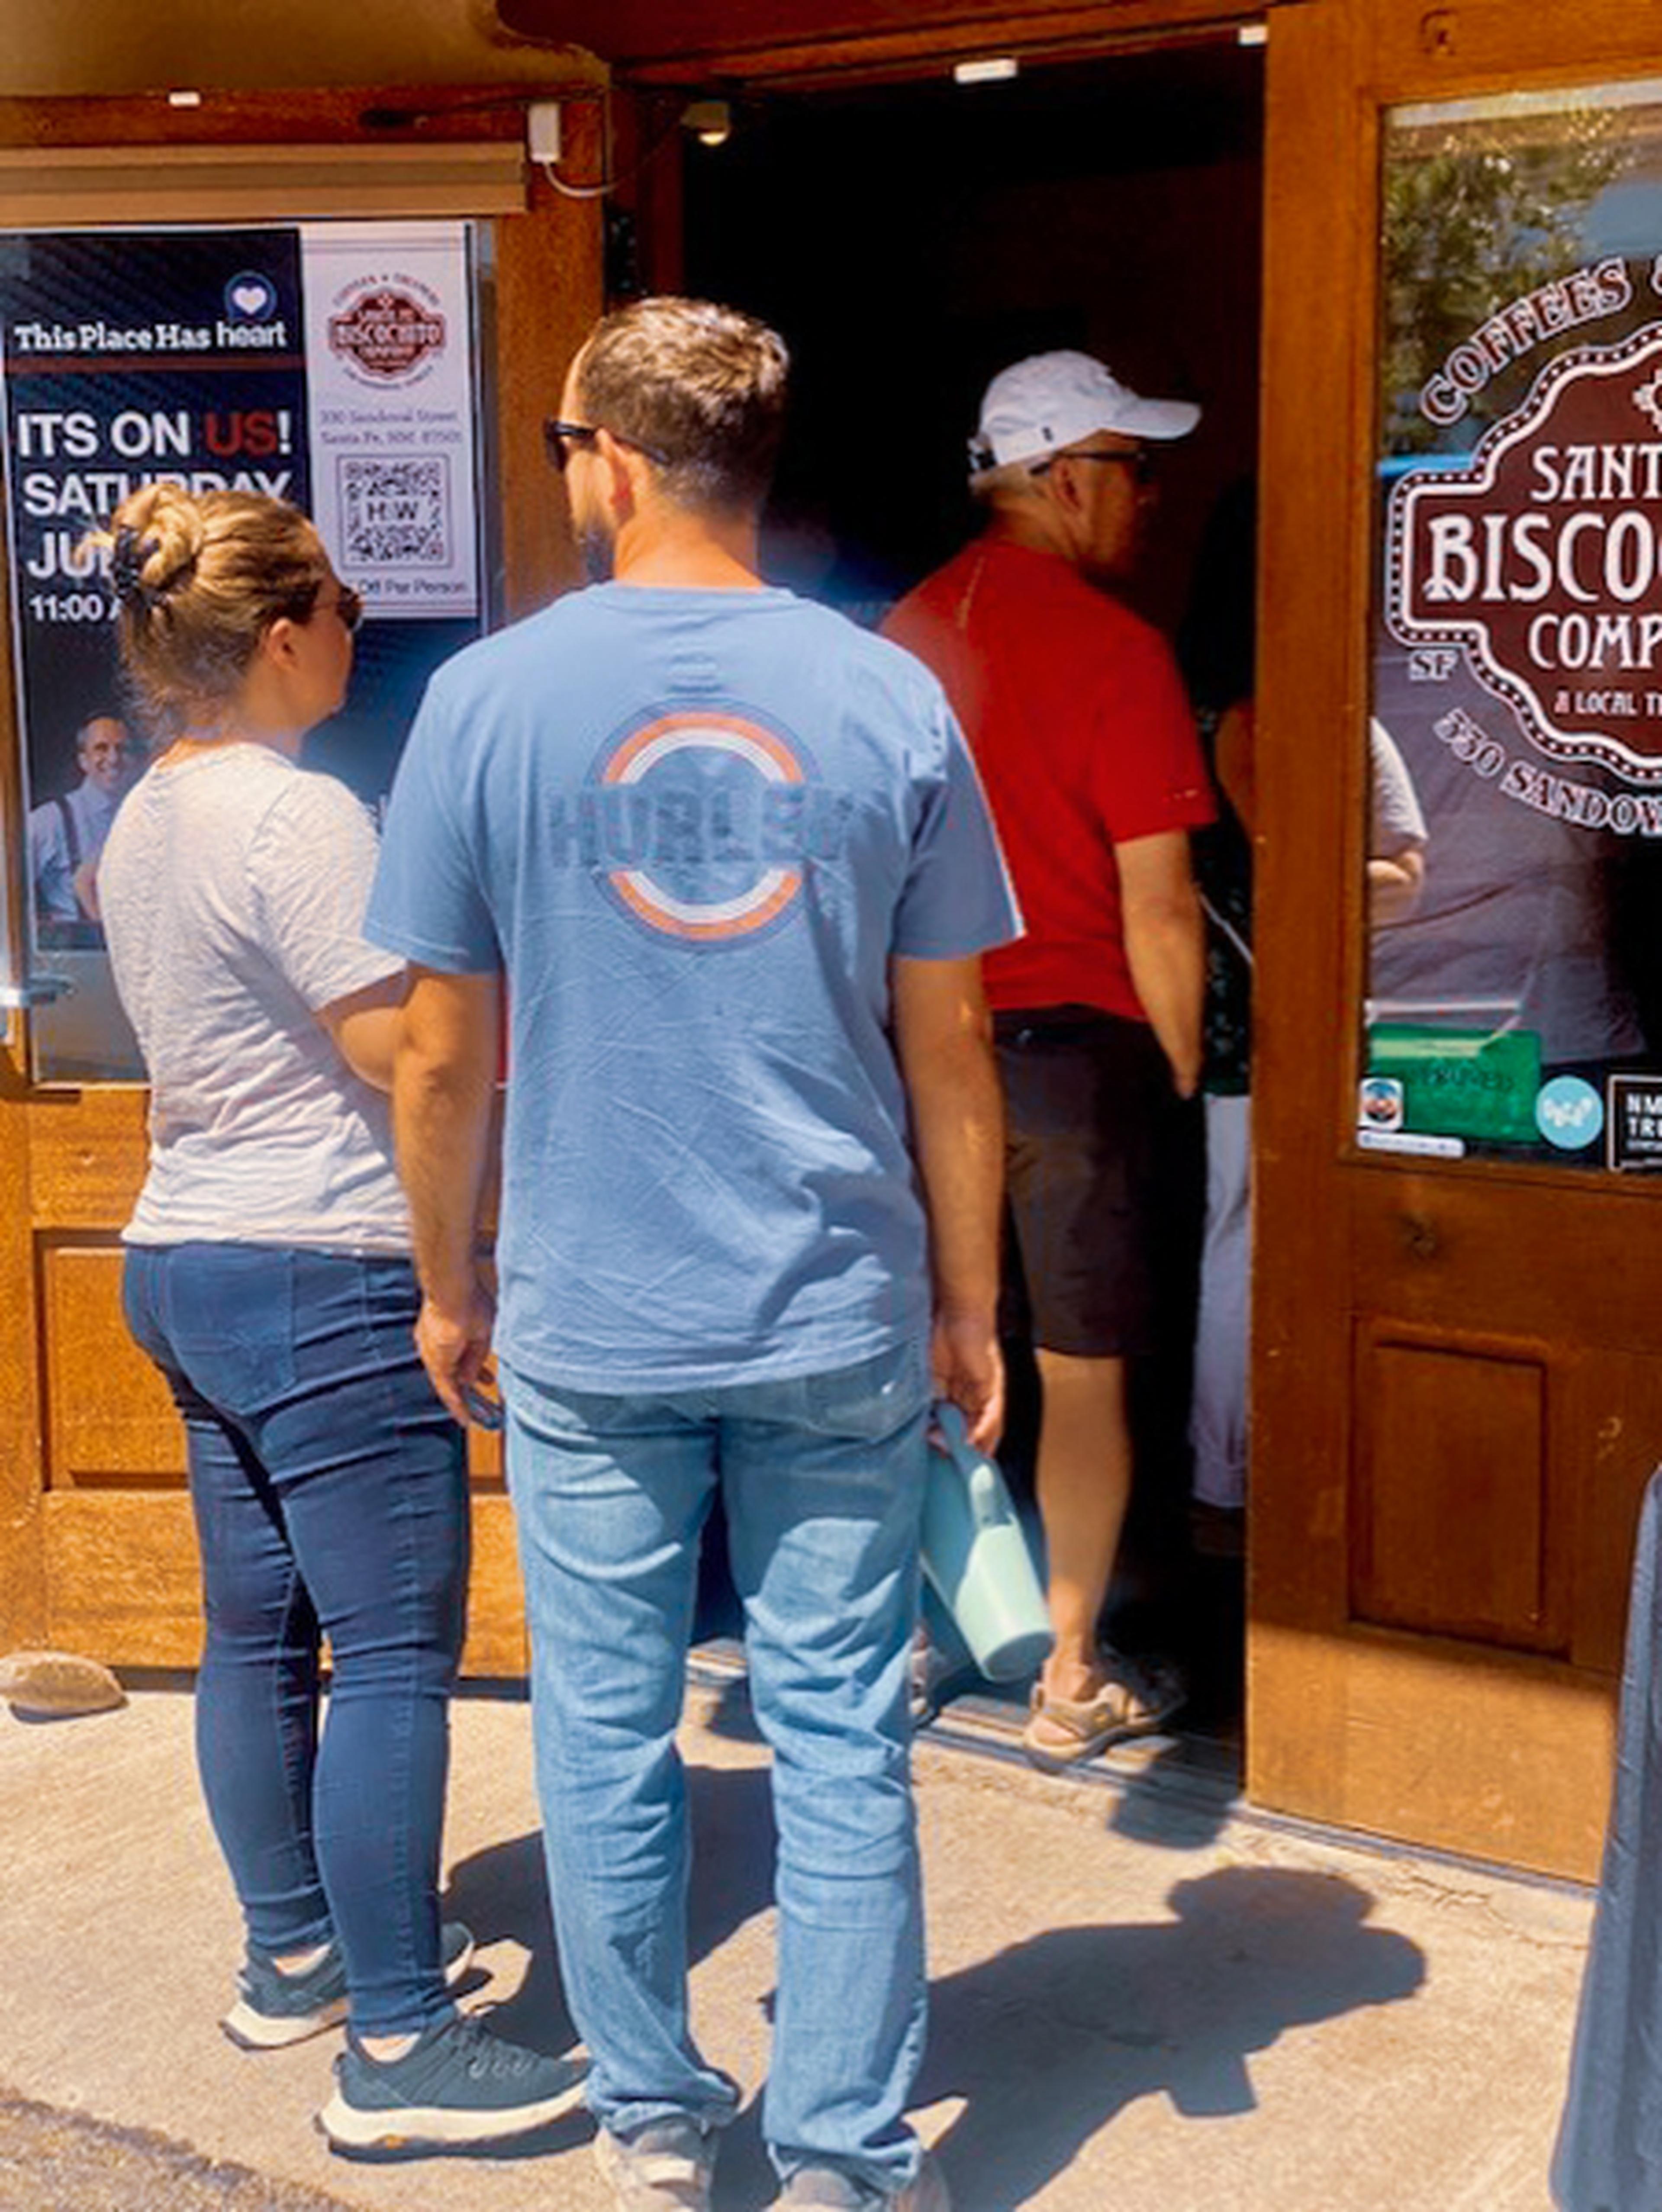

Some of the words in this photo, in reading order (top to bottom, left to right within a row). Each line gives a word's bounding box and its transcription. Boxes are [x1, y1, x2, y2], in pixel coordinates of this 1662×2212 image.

[14, 321, 77, 350] This
[78, 321, 152, 350] Place
[155, 324, 211, 350] Has
[217, 320, 287, 347] heart
[1420, 257, 1633, 425] COFFEES
[18, 412, 98, 457] ITS
[111, 410, 190, 457] ON
[204, 409, 292, 456] US!
[28, 531, 113, 579] JU
[1423, 512, 1662, 602] BISCO
[29, 595, 104, 621] 11:00
[414, 578, 467, 594] Person
[1529, 614, 1662, 669] COMP
[1574, 690, 1637, 715] LOCAL
